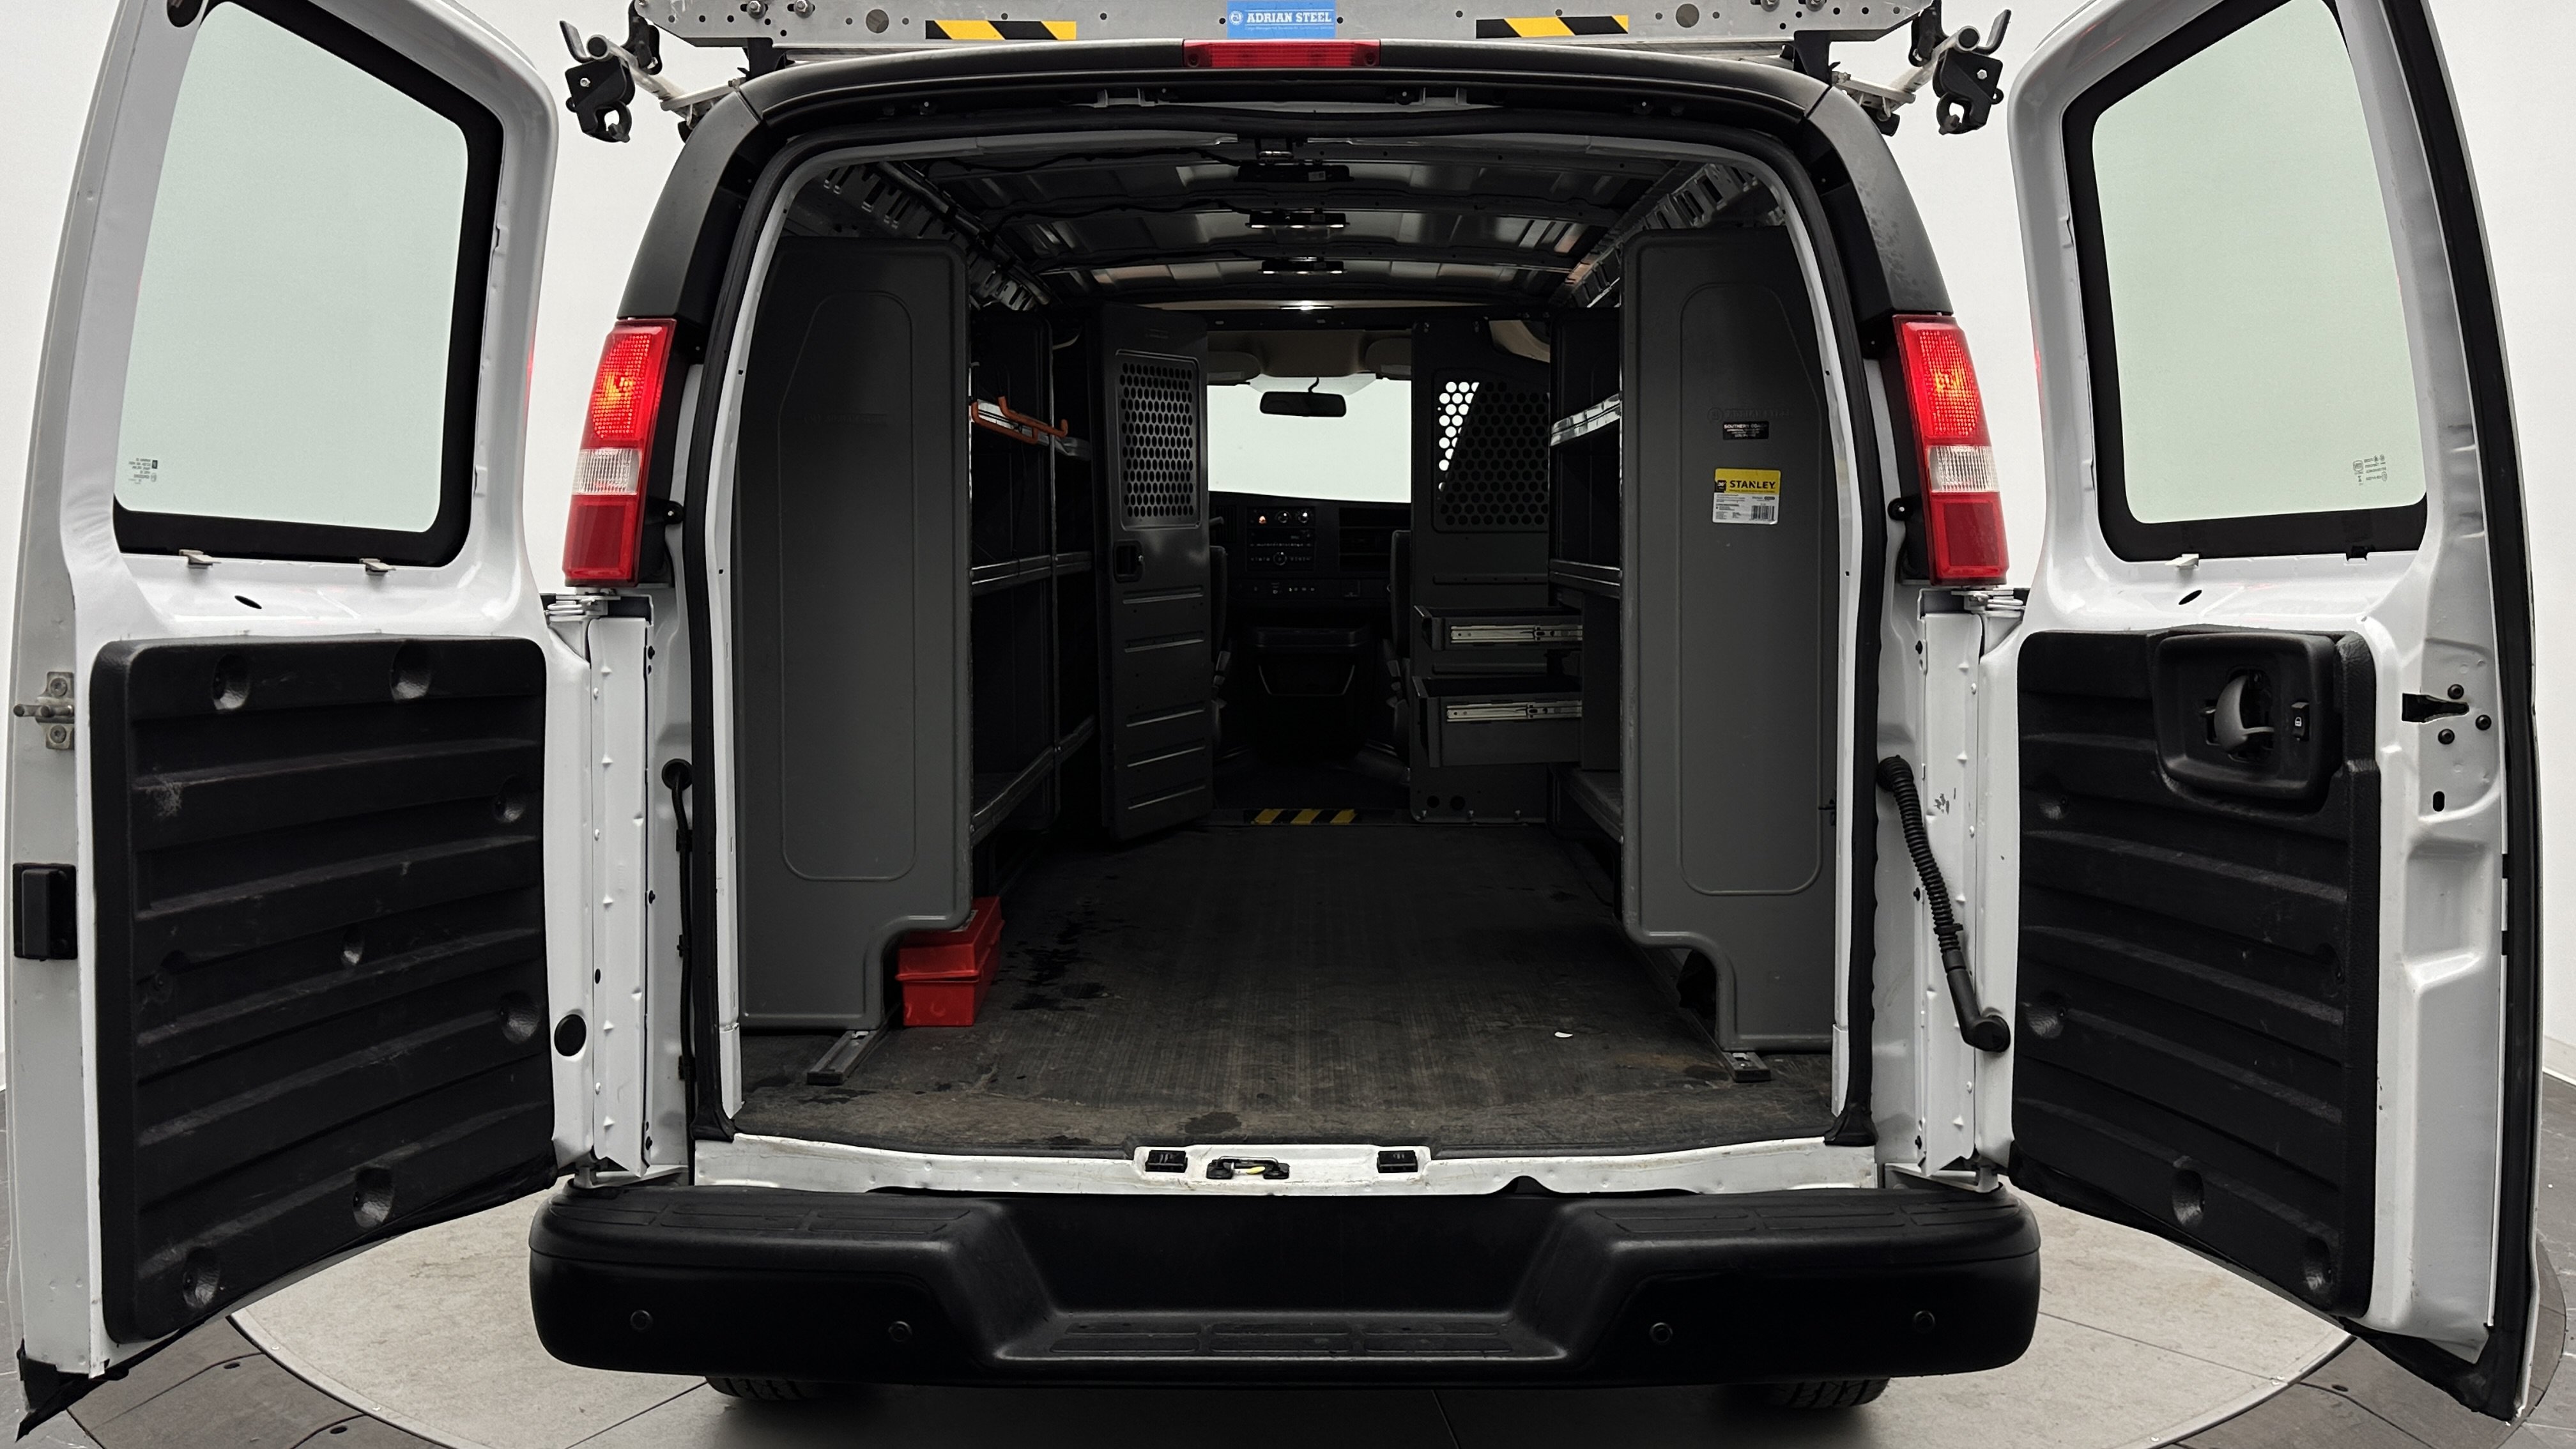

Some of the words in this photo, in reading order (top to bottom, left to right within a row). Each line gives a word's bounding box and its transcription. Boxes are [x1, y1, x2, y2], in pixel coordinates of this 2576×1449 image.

[1246, 12, 1292, 23] ADRIAN
[1295, 12, 1332, 22] STEEL
[1729, 480, 1775, 489] STANLEY
